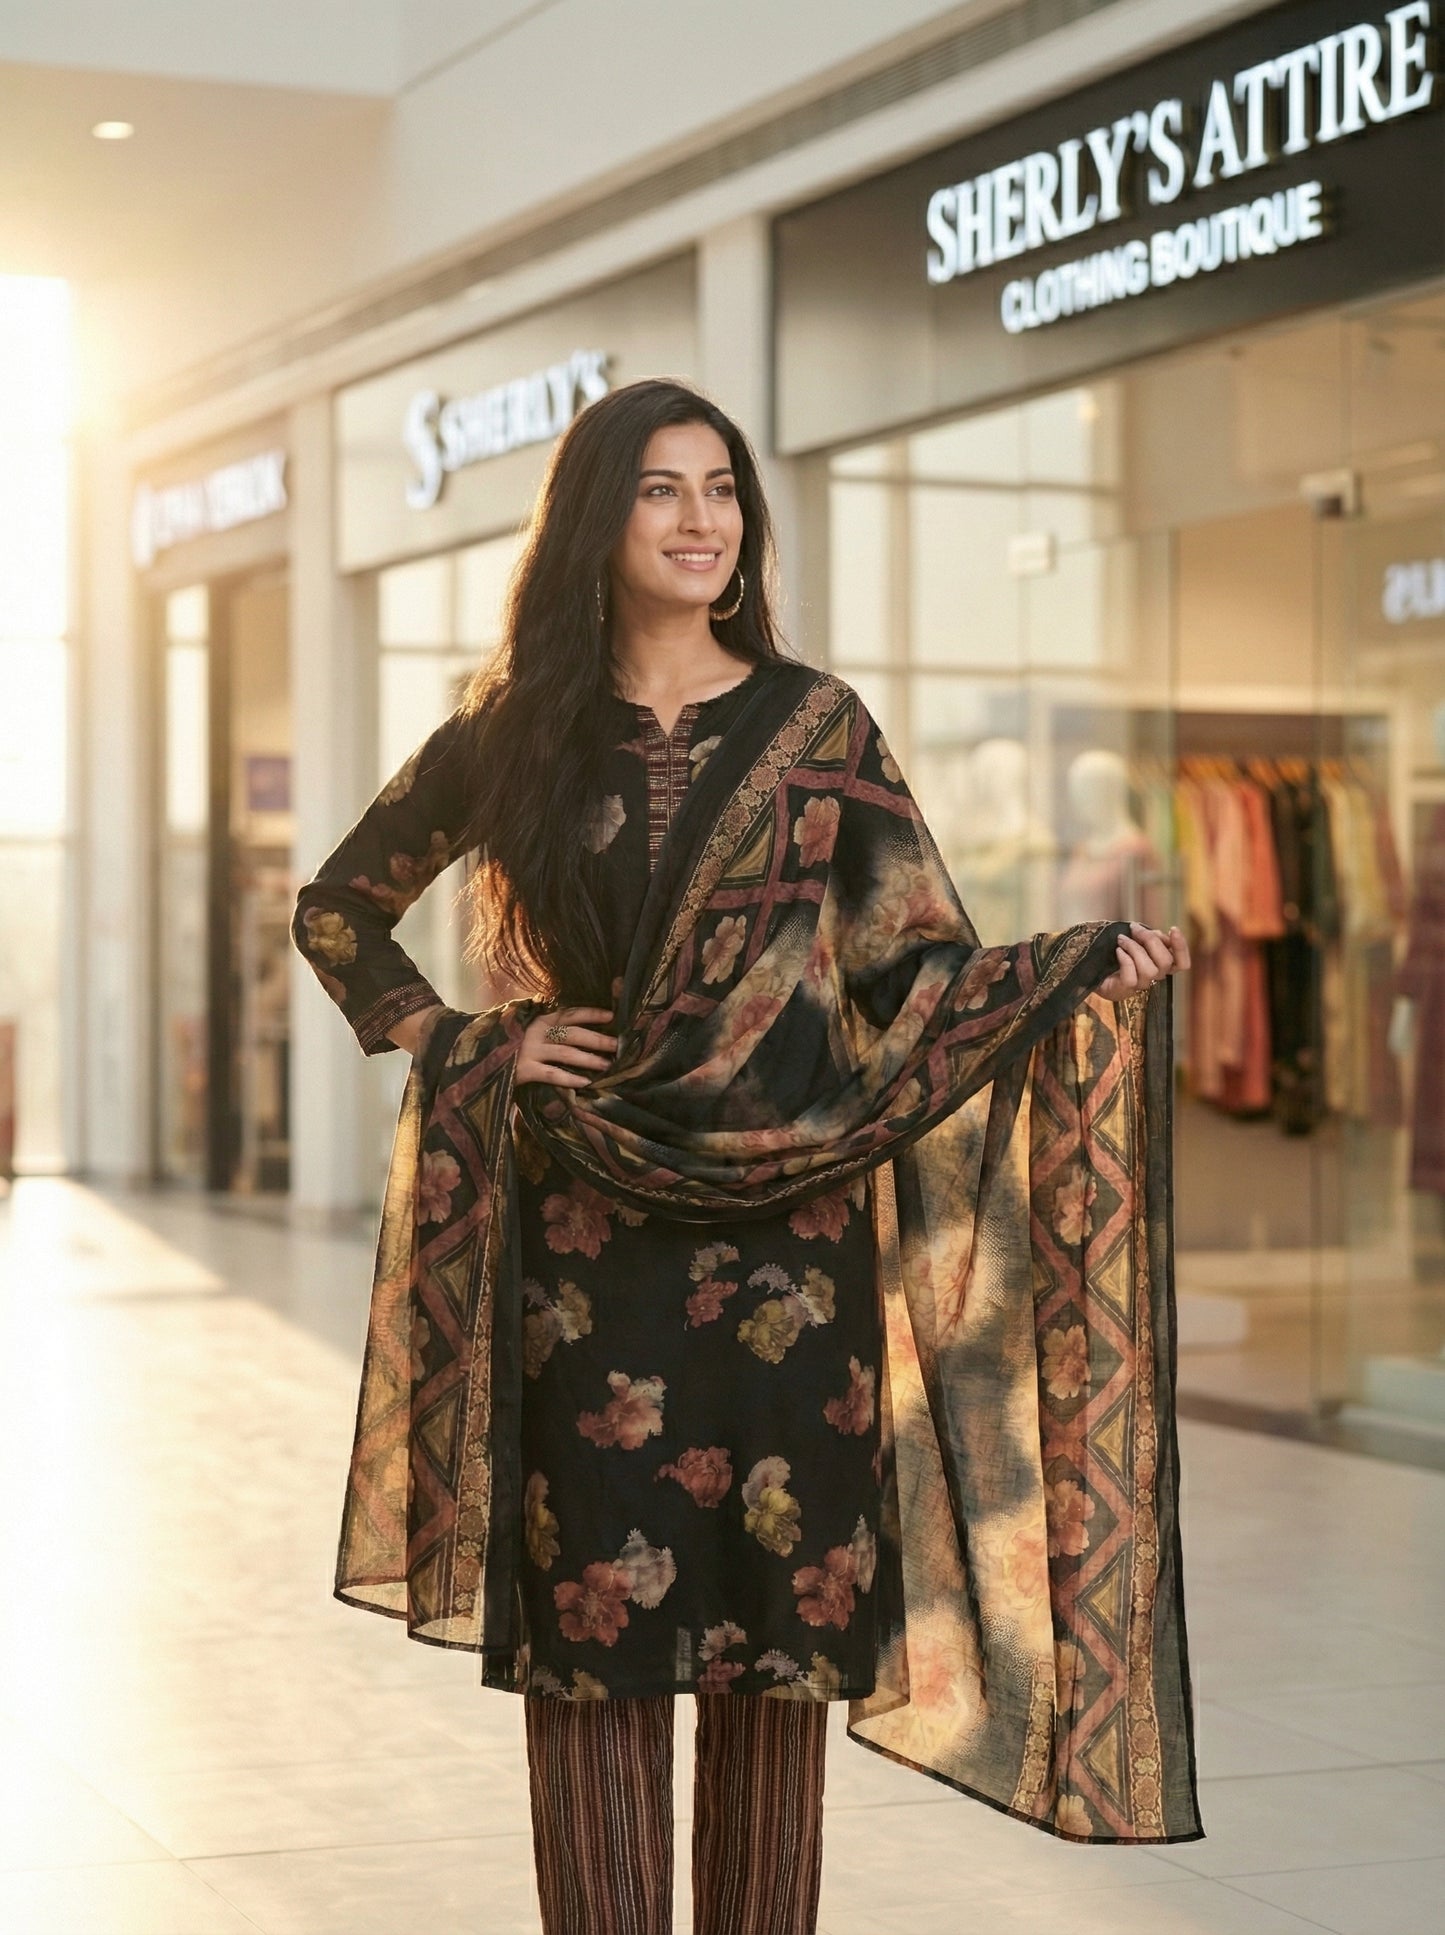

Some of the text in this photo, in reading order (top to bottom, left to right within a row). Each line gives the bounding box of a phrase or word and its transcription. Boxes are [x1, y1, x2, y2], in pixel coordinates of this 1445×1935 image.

[927, 1, 1433, 284] SHERLY'S ATTIRE
[1001, 180, 1323, 334] CLOTHING BOUTIQUE
